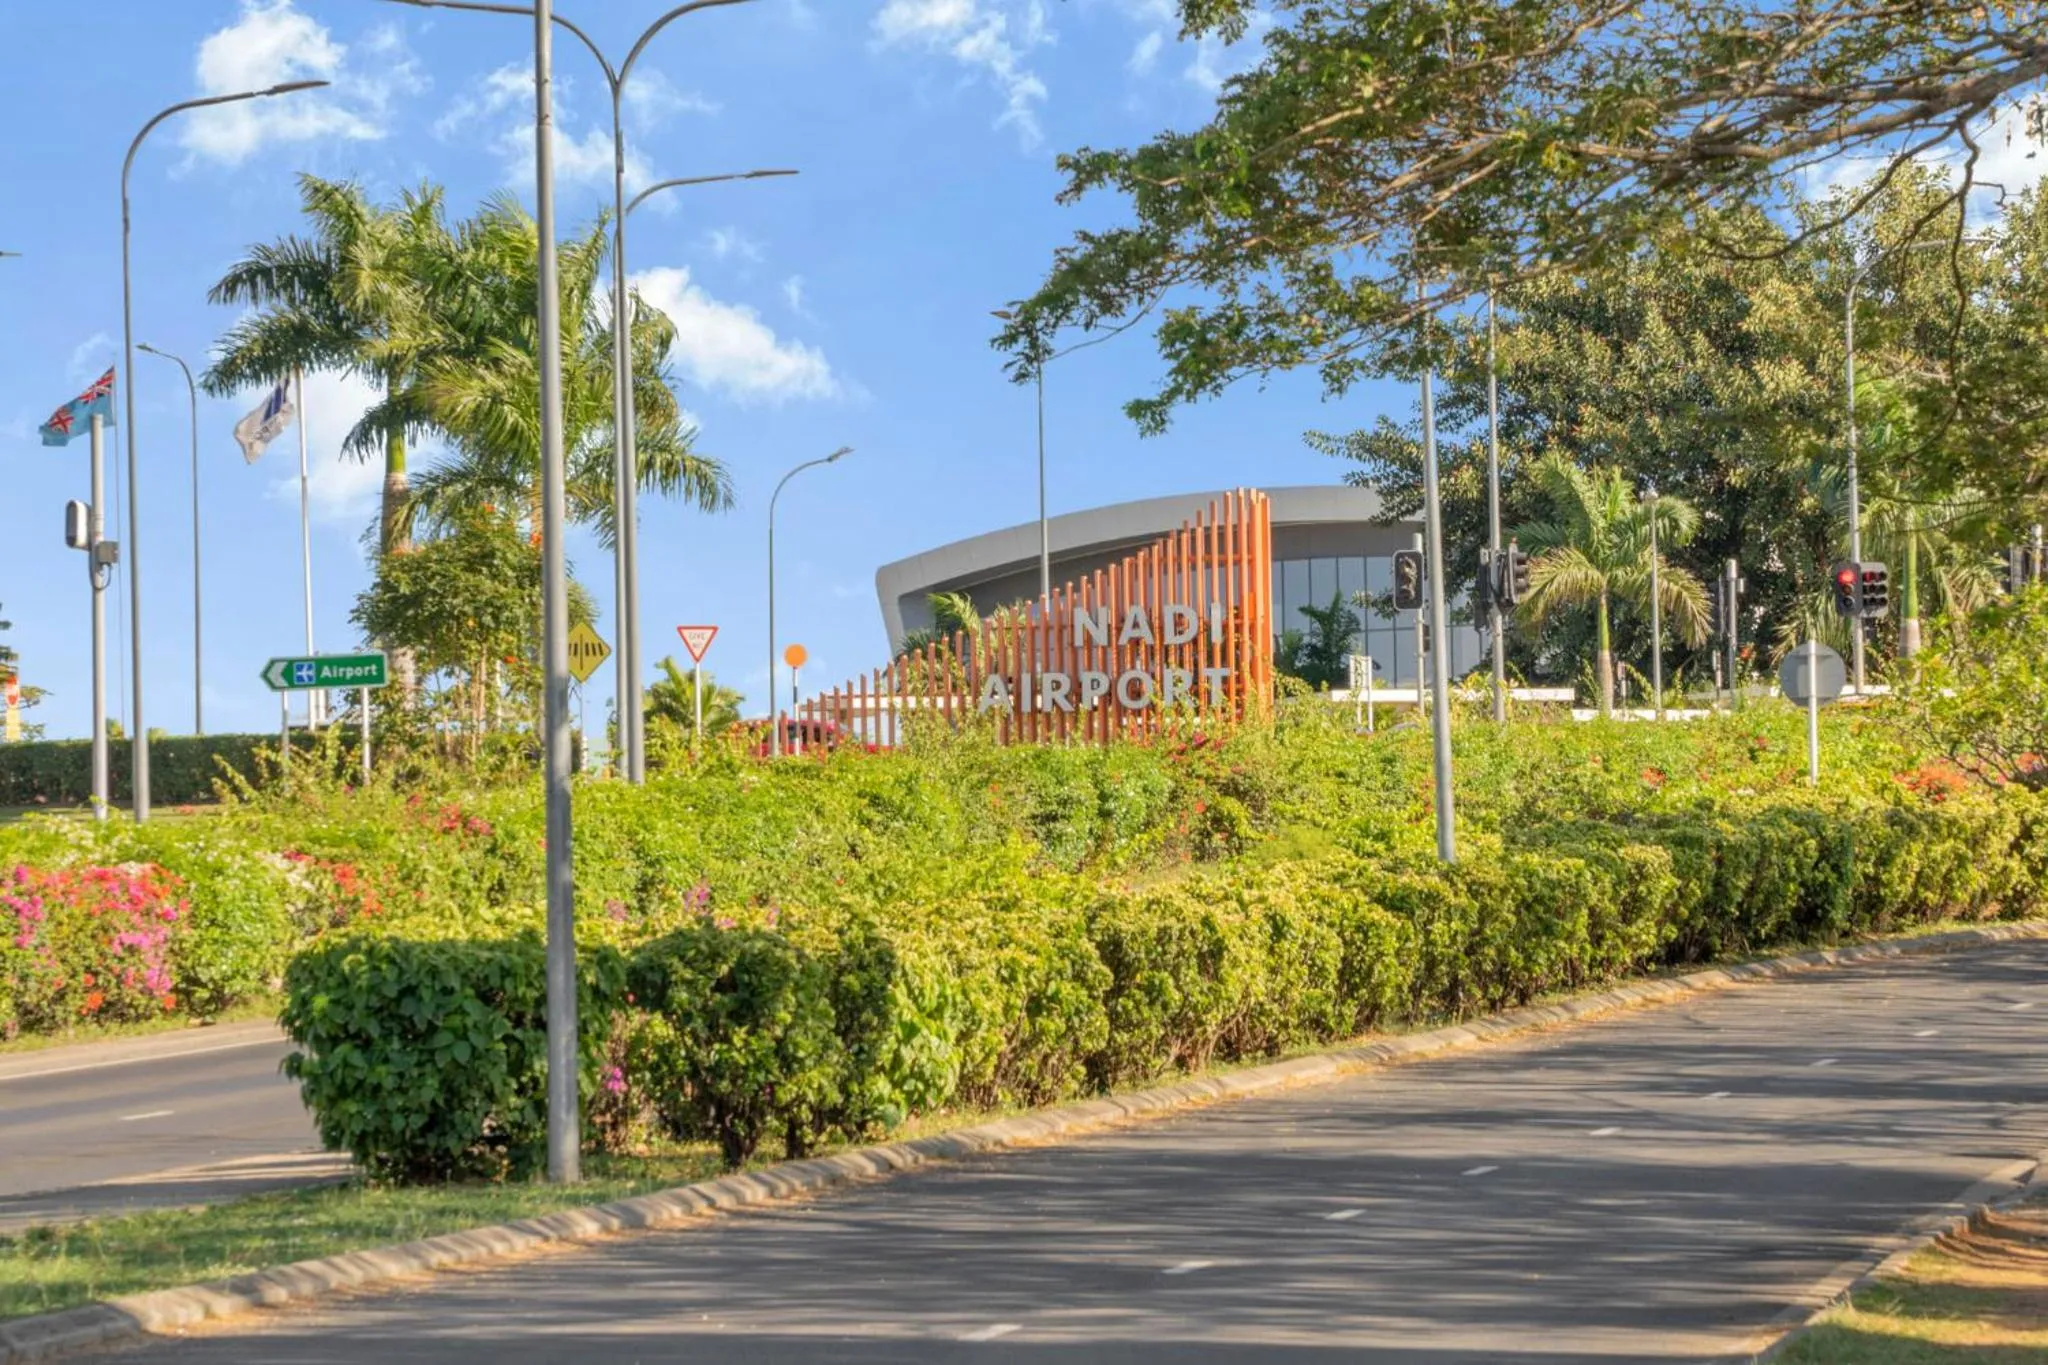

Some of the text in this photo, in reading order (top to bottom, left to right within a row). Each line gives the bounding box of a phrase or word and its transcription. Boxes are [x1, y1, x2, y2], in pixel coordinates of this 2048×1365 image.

[1073, 602, 1223, 647] NADI
[320, 663, 378, 679] Airport
[977, 667, 1230, 713] AIRPORT
